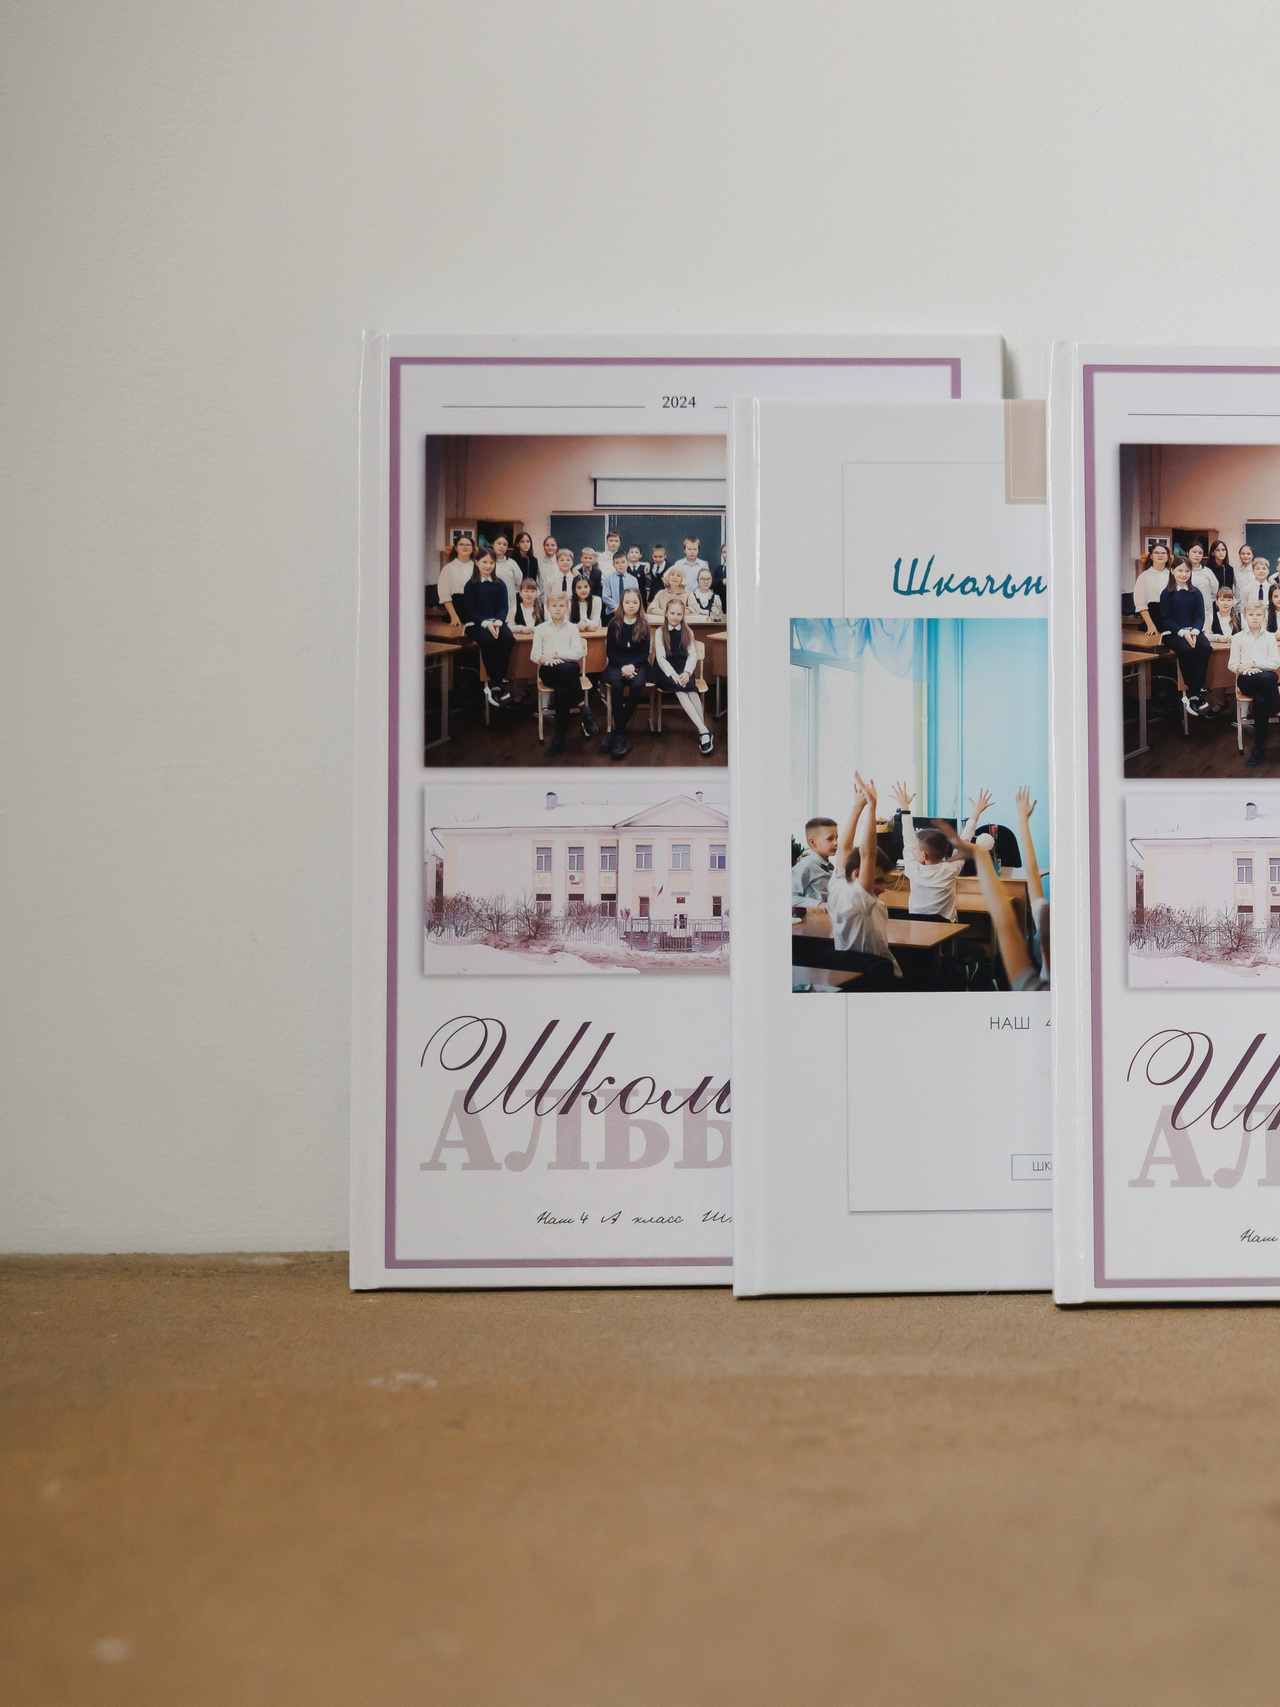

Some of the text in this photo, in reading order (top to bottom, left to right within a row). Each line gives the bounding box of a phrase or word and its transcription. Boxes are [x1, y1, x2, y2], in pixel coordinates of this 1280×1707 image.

[662, 395, 697, 409] 2024
[892, 554, 1048, 600] Школьн
[989, 1016, 1030, 1030] НАШ
[1032, 1160, 1053, 1172] ШК
[536, 1210, 575, 1225] Наш
[579, 1211, 589, 1225] 4
[601, 1210, 623, 1225] А
[702, 1210, 733, 1224] Ш
[1240, 1228, 1279, 1243] Наш
